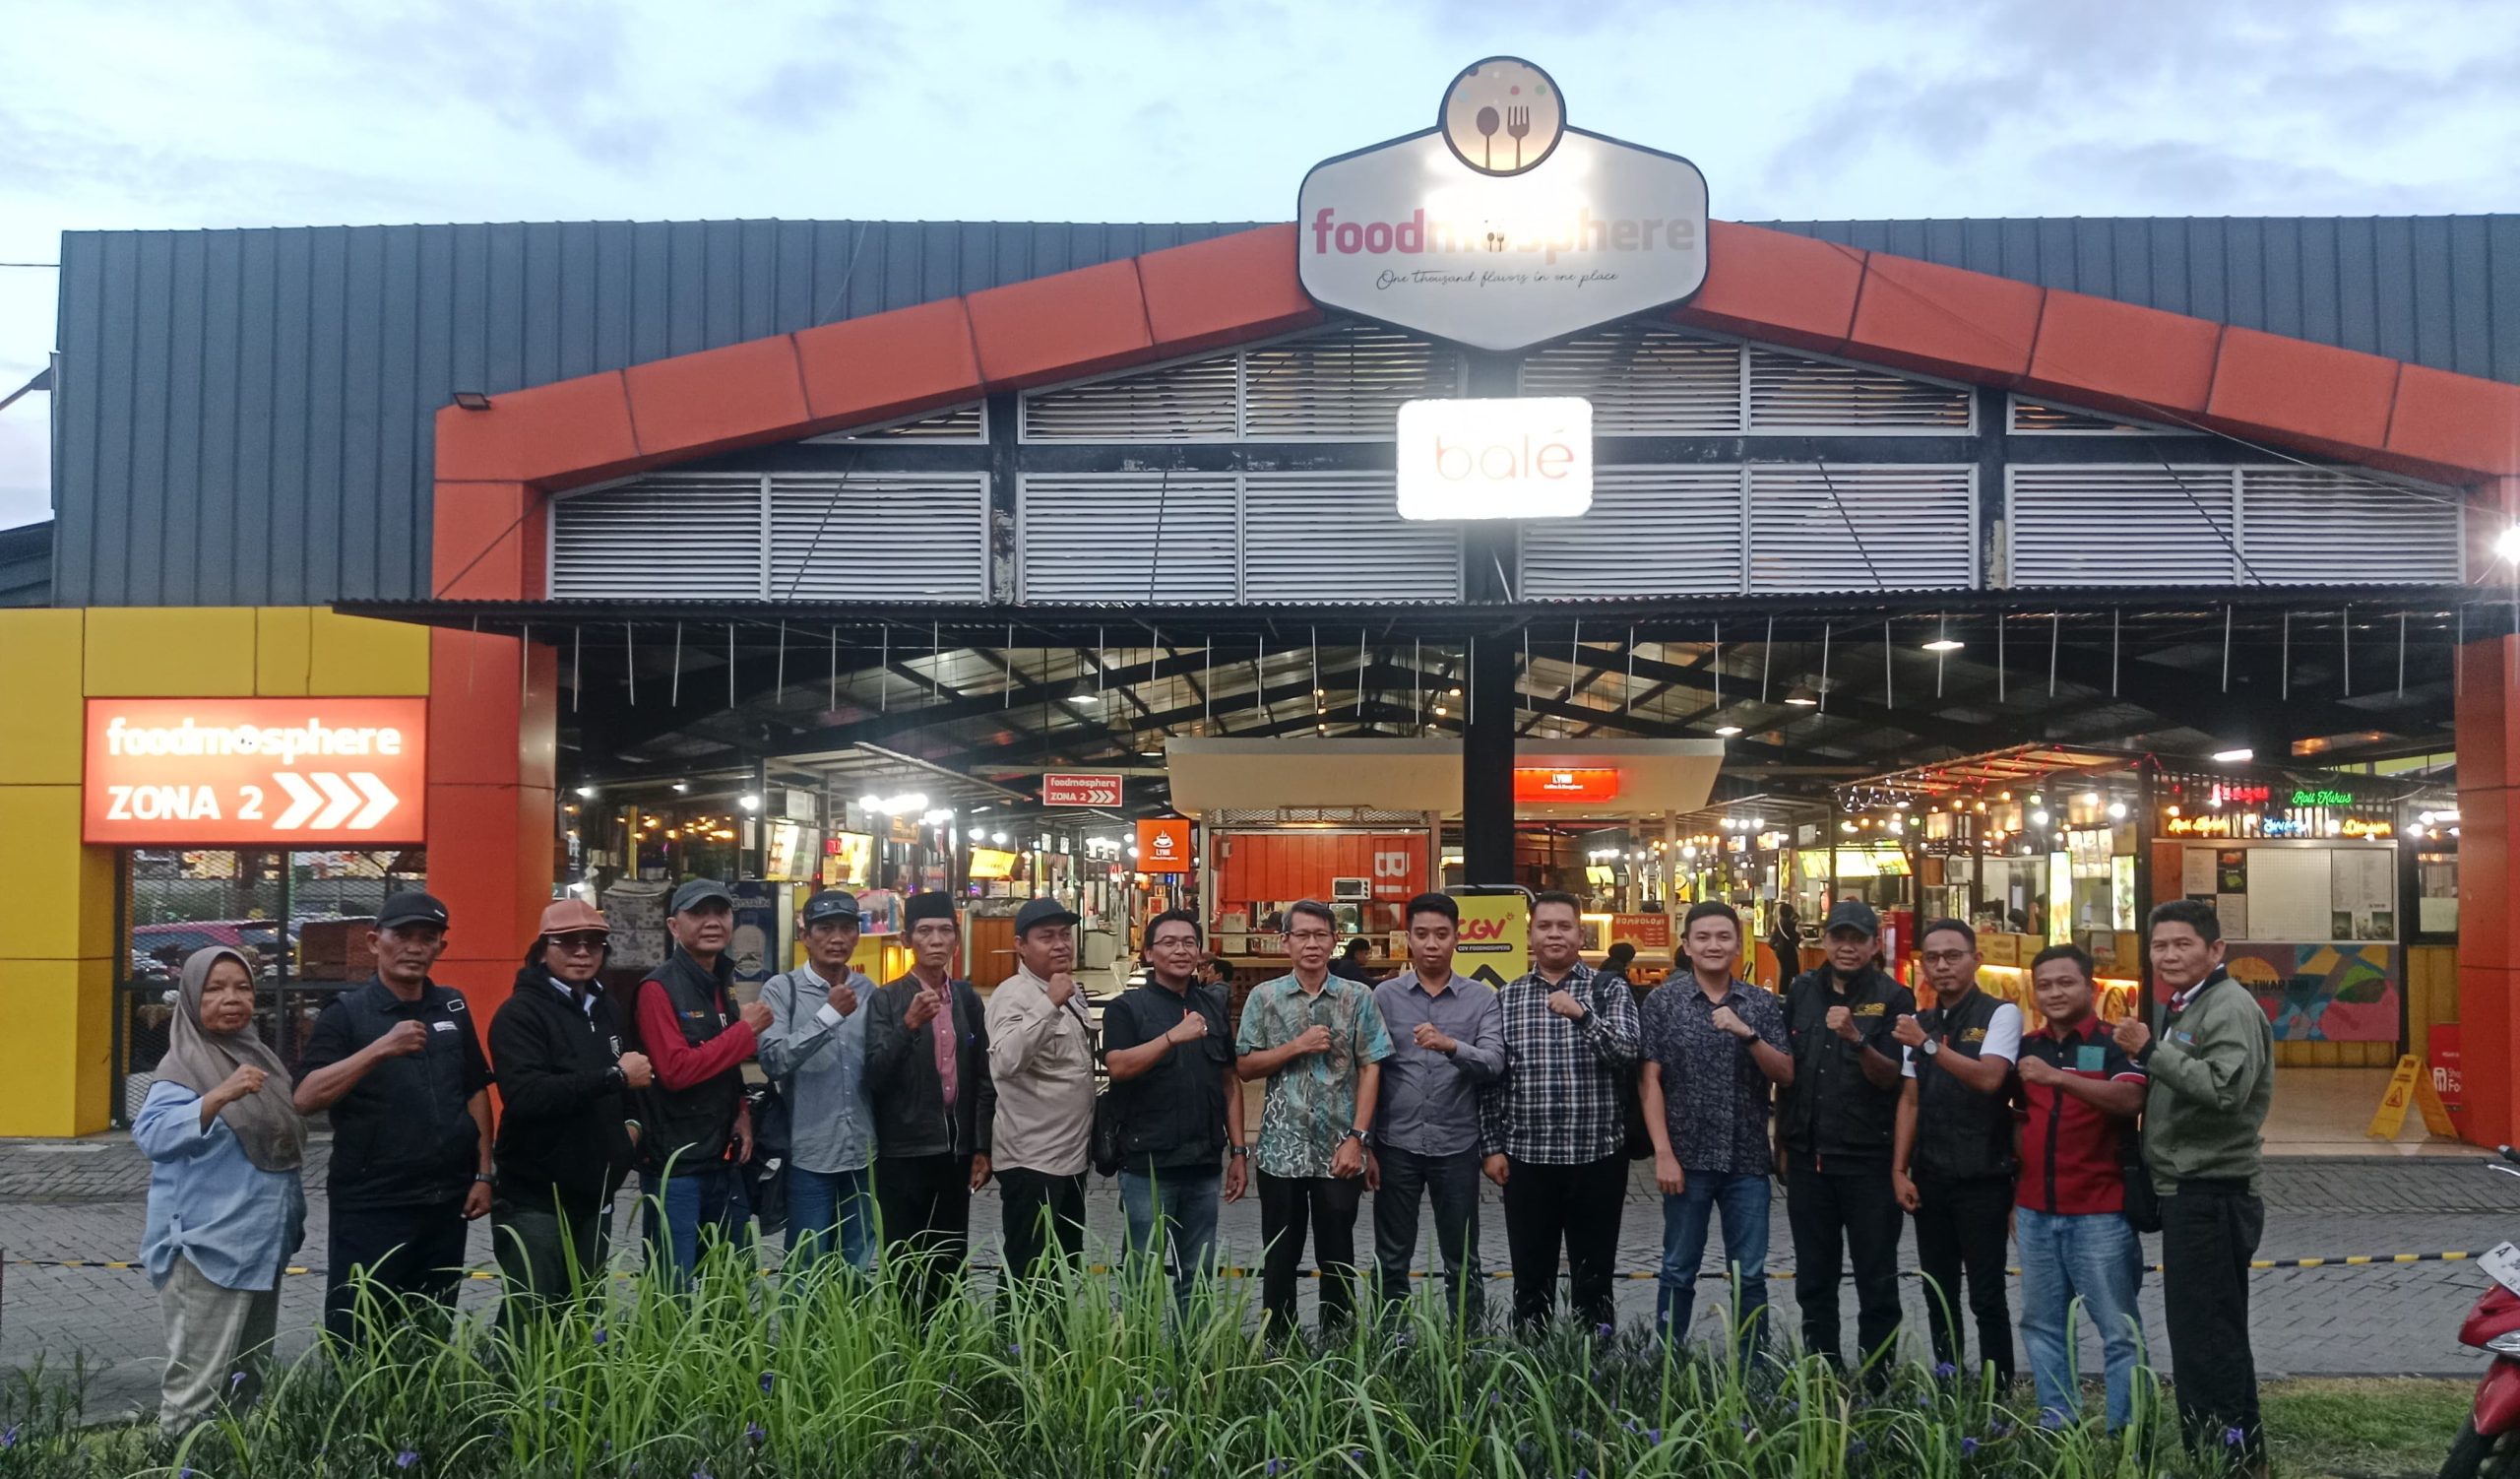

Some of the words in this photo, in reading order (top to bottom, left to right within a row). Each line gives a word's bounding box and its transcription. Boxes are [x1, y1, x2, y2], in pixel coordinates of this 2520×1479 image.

[1376, 269, 1409, 289] One
[1412, 270, 1475, 286] thousand
[1534, 272, 1548, 282] in
[1578, 269, 1618, 288] place
[106, 717, 402, 765] foodmosphere
[1050, 777, 1116, 789] foodmosphere
[106, 785, 221, 820] ZONA
[237, 785, 264, 820] 2
[1050, 792, 1077, 801] ZONA
[2317, 790, 2352, 807] Kukus
[1458, 919, 1506, 940] CGV
